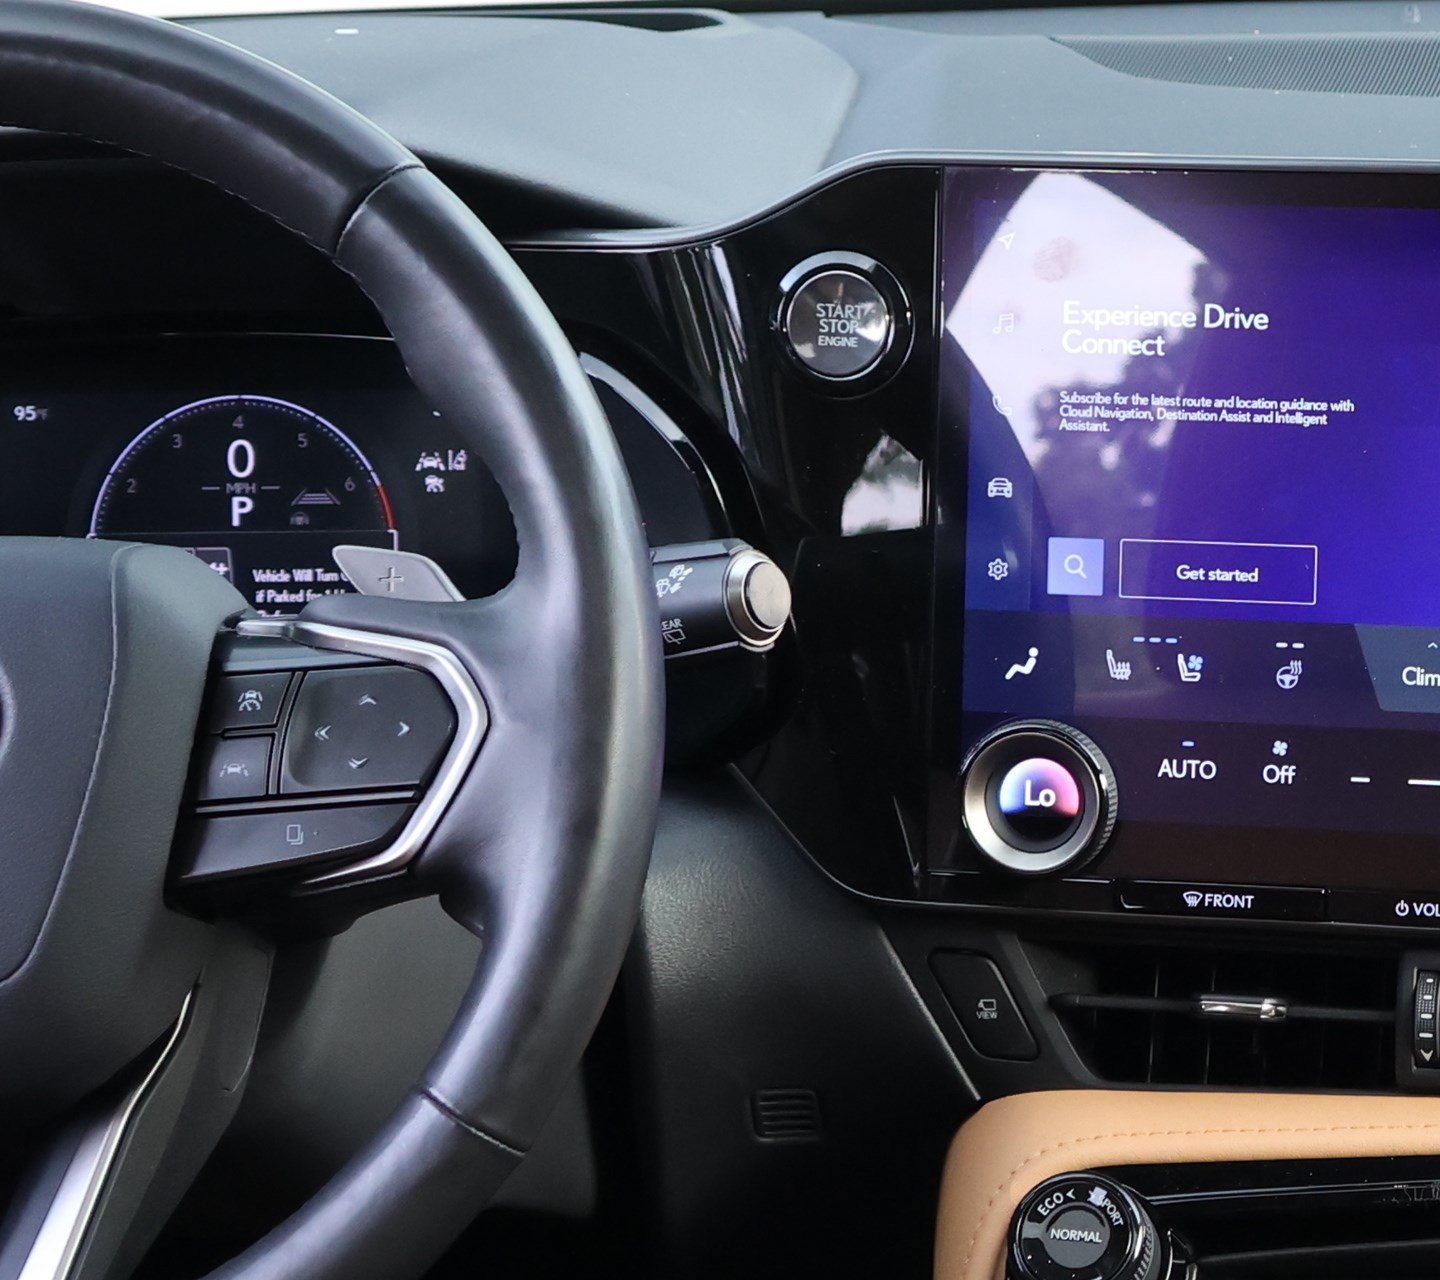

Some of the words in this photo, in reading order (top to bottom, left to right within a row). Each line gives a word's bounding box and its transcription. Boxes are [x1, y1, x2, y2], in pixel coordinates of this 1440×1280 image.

[1062, 300, 1197, 331] Experience
[1203, 303, 1270, 331] Drive
[818, 319, 860, 334] STOP
[817, 335, 859, 348] ENGINE
[1061, 329, 1166, 357] Connect
[1059, 390, 1112, 405] Subscribe
[1113, 392, 1129, 405] for
[1131, 392, 1149, 406] the
[1151, 393, 1181, 407] latest
[1182, 395, 1213, 408] route
[1213, 395, 1235, 408] and
[1235, 396, 1278, 410] location
[1279, 397, 1328, 413] guidance
[1329, 399, 1355, 412] with
[232, 415, 245, 429] 4
[1059, 404, 1093, 418] Cloud
[1094, 405, 1155, 422] Navigation,
[1156, 407, 1218, 422] Destination
[1218, 409, 1252, 423] Assist
[1252, 411, 1274, 424] and
[1274, 411, 1328, 428] Intelligent
[1058, 418, 1111, 432] Assistant.
[172, 433, 183, 449] 3
[297, 433, 309, 449] 5
[226, 438, 256, 479] 0
[126, 478, 137, 494] 2
[225, 483, 257, 494] MPH
[344, 476, 356, 492] 6
[230, 496, 254, 527] P
[252, 568, 291, 583] Vehicle
[292, 568, 314, 582] Will
[315, 568, 340, 582] Turn
[1175, 564, 1205, 585] Get
[1208, 565, 1259, 585] started
[255, 589, 266, 604] if
[266, 589, 305, 603] Parked
[661, 618, 683, 631] EAR
[1157, 759, 1217, 781] AUTO
[1262, 763, 1297, 786] Off
[1024, 780, 1057, 807] Lo
[1203, 892, 1255, 910] FRONT
[975, 1010, 999, 1020] VIEW
[1036, 1191, 1065, 1216] ECO
[1050, 1228, 1103, 1243] NORMAL
